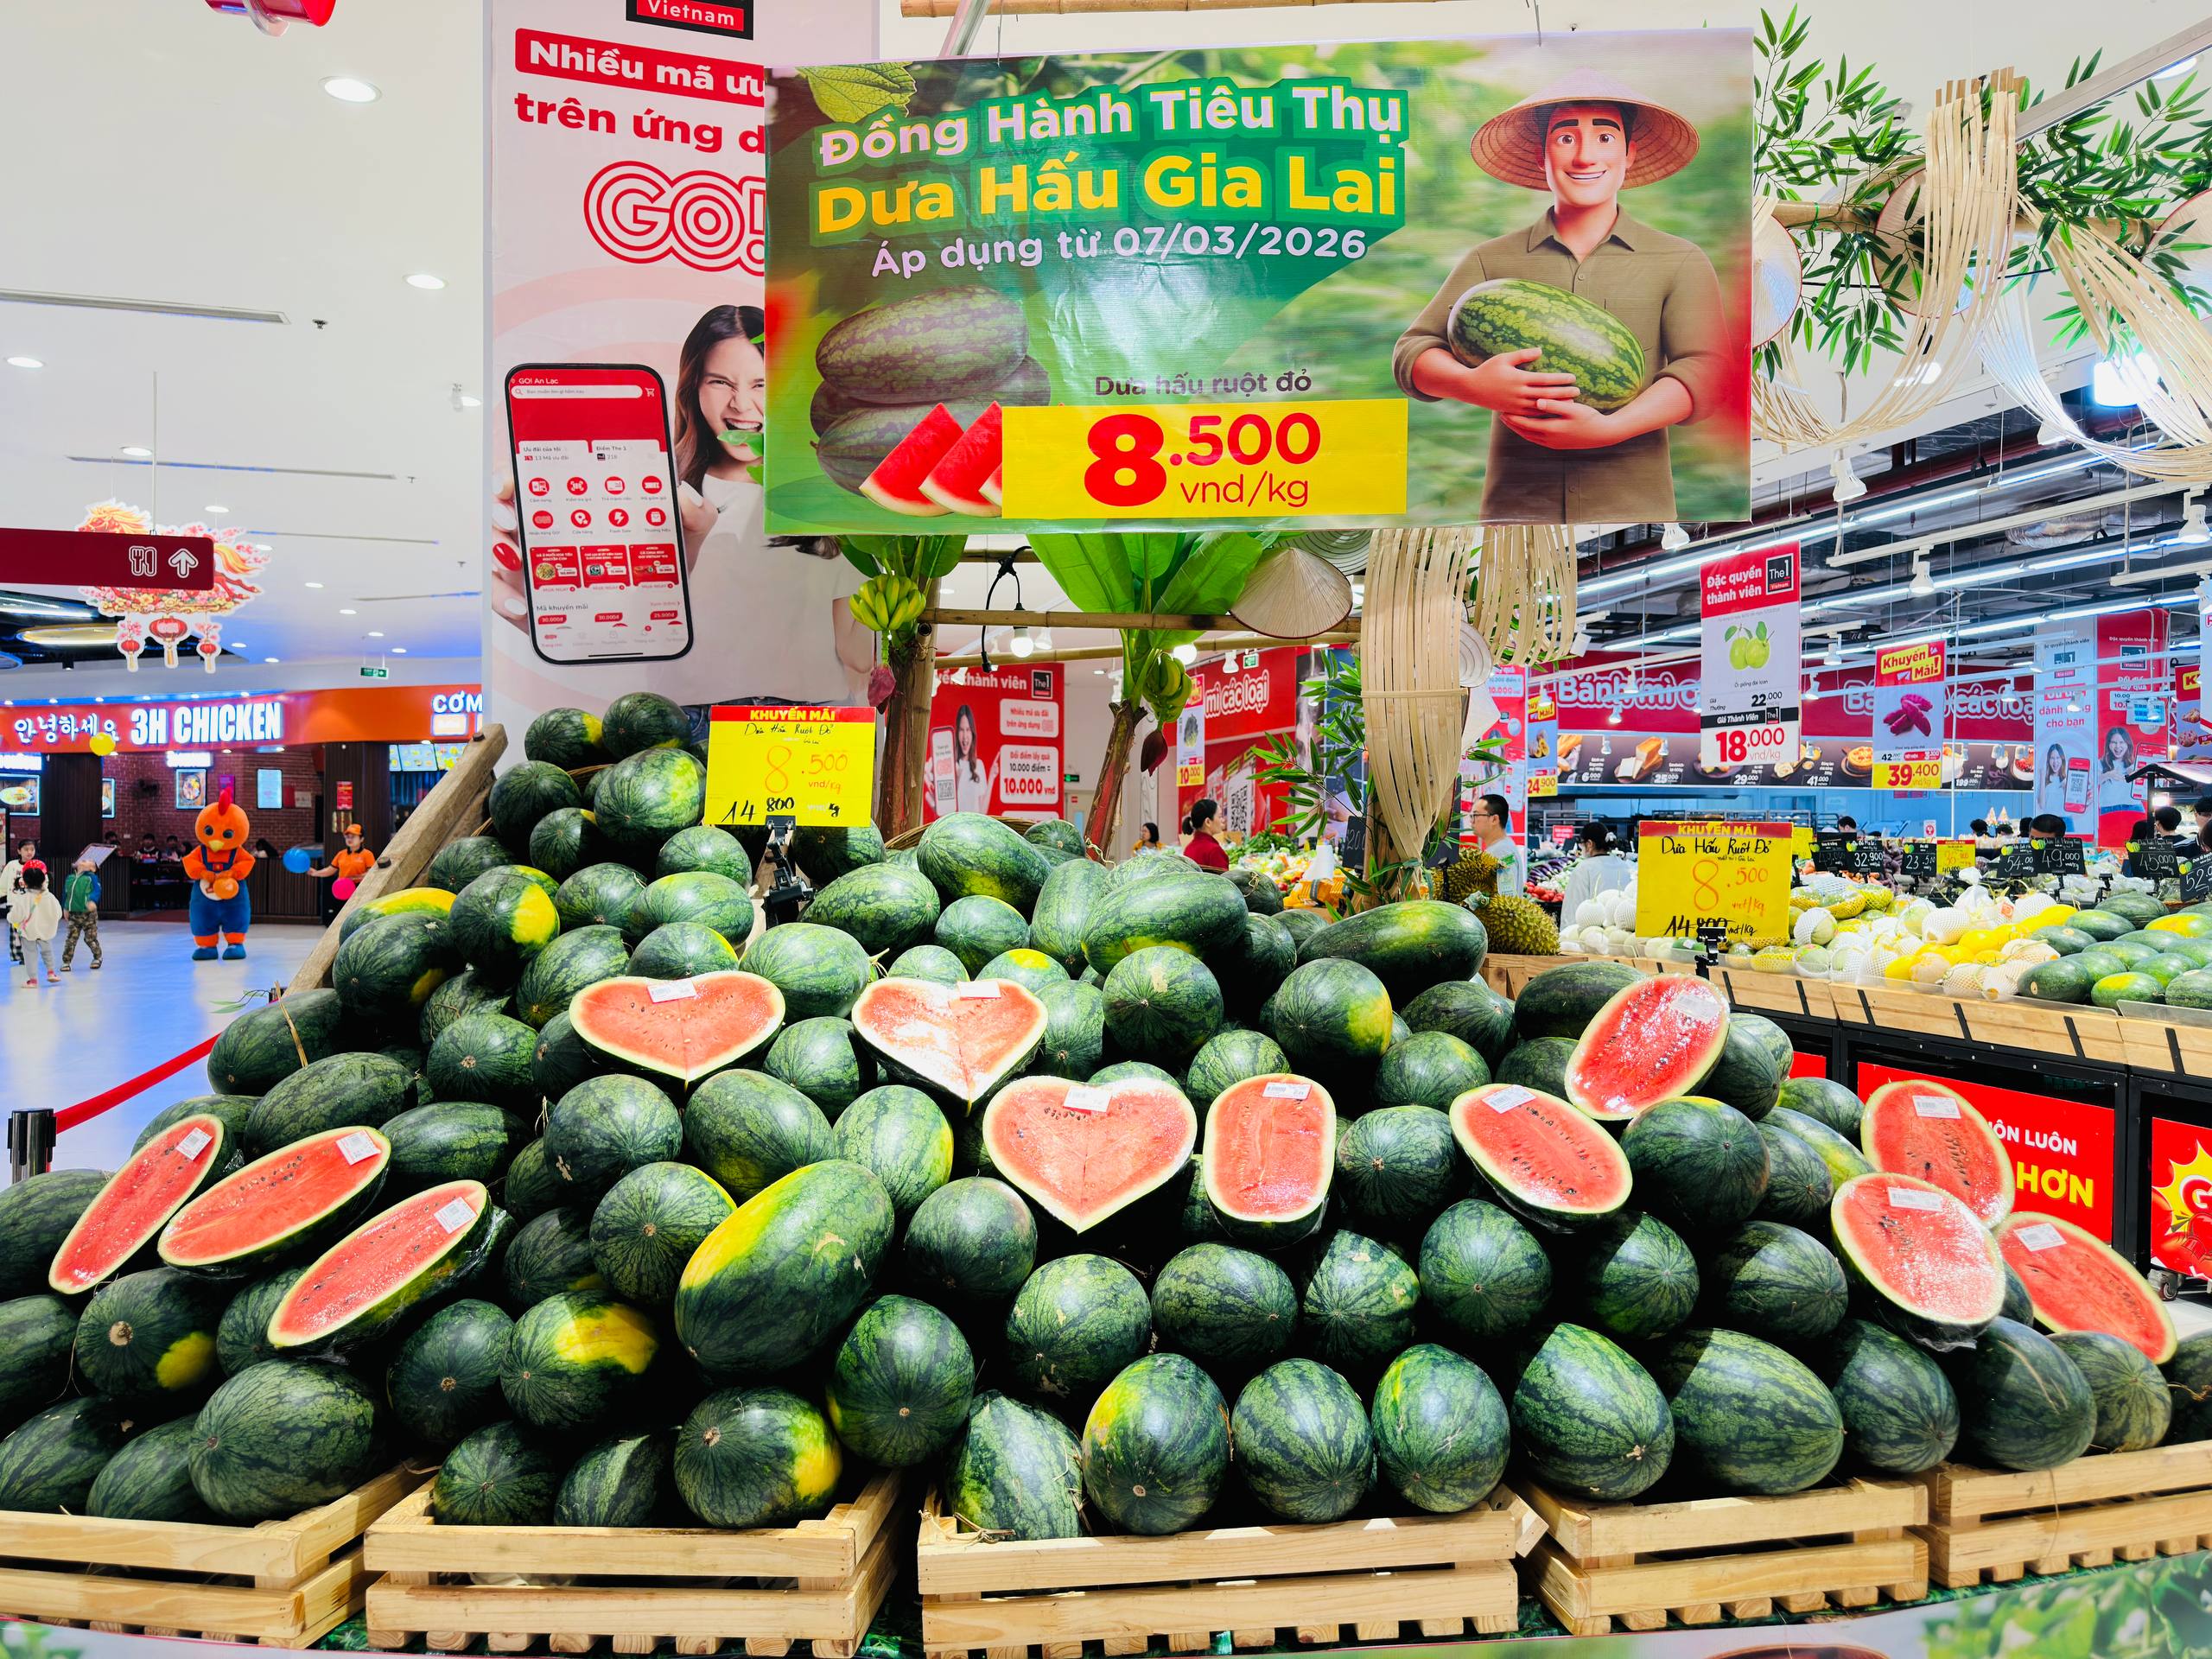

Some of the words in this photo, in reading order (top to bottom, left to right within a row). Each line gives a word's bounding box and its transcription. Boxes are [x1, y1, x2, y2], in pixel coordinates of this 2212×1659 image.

[648, 0, 734, 27] Vietnam
[530, 40, 644, 80] Nhiều
[657, 65, 714, 91] mã
[514, 92, 616, 134] trên
[632, 108, 722, 154] ứng
[819, 116, 967, 167] Đồng
[988, 92, 1133, 143] Hành
[1149, 88, 1274, 132] Tiêu
[1292, 87, 1402, 143] Thụ
[817, 179, 954, 233] Dưa
[980, 150, 1118, 215] Hấu
[1143, 153, 1262, 208] Gia
[1289, 156, 1396, 215] Lai
[871, 240, 926, 279] Áp
[941, 235, 1042, 274] dụng
[1058, 230, 1103, 257] từ
[1114, 221, 1367, 260] 07/03/2026
[1095, 375, 1147, 397] Dưa
[1154, 369, 1203, 396] hấu
[1212, 372, 1268, 395] ruột
[1276, 368, 1312, 393] đỏ
[1084, 412, 1322, 508] 8.500
[1180, 477, 1309, 507] vnd/kg
[1707, 588, 1736, 605] thành
[1738, 584, 1762, 599] viên
[964, 672, 998, 688] hành
[1001, 675, 1027, 690] viên
[432, 690, 482, 713] CƠM
[1751, 691, 1783, 707] 22.000
[130, 708, 167, 746] 3H
[174, 702, 282, 743] CHICKEN
[750, 706, 807, 721] KHUYẾN
[810, 708, 836, 721] MÃI
[2046, 718, 2063, 728] cho
[1715, 728, 1785, 762] 18.000
[1750, 748, 1781, 761] vnd/kg
[1009, 763, 1030, 772] 10.000
[1887, 764, 1940, 786] 39.400
[1004, 778, 1042, 794] 10.000
[1734, 824, 1758, 836] MÃI
[1988, 1119, 2020, 1142] ÔN
[2024, 1131, 2076, 1156] LUÔN
[2017, 1160, 2094, 1209] HƠN
